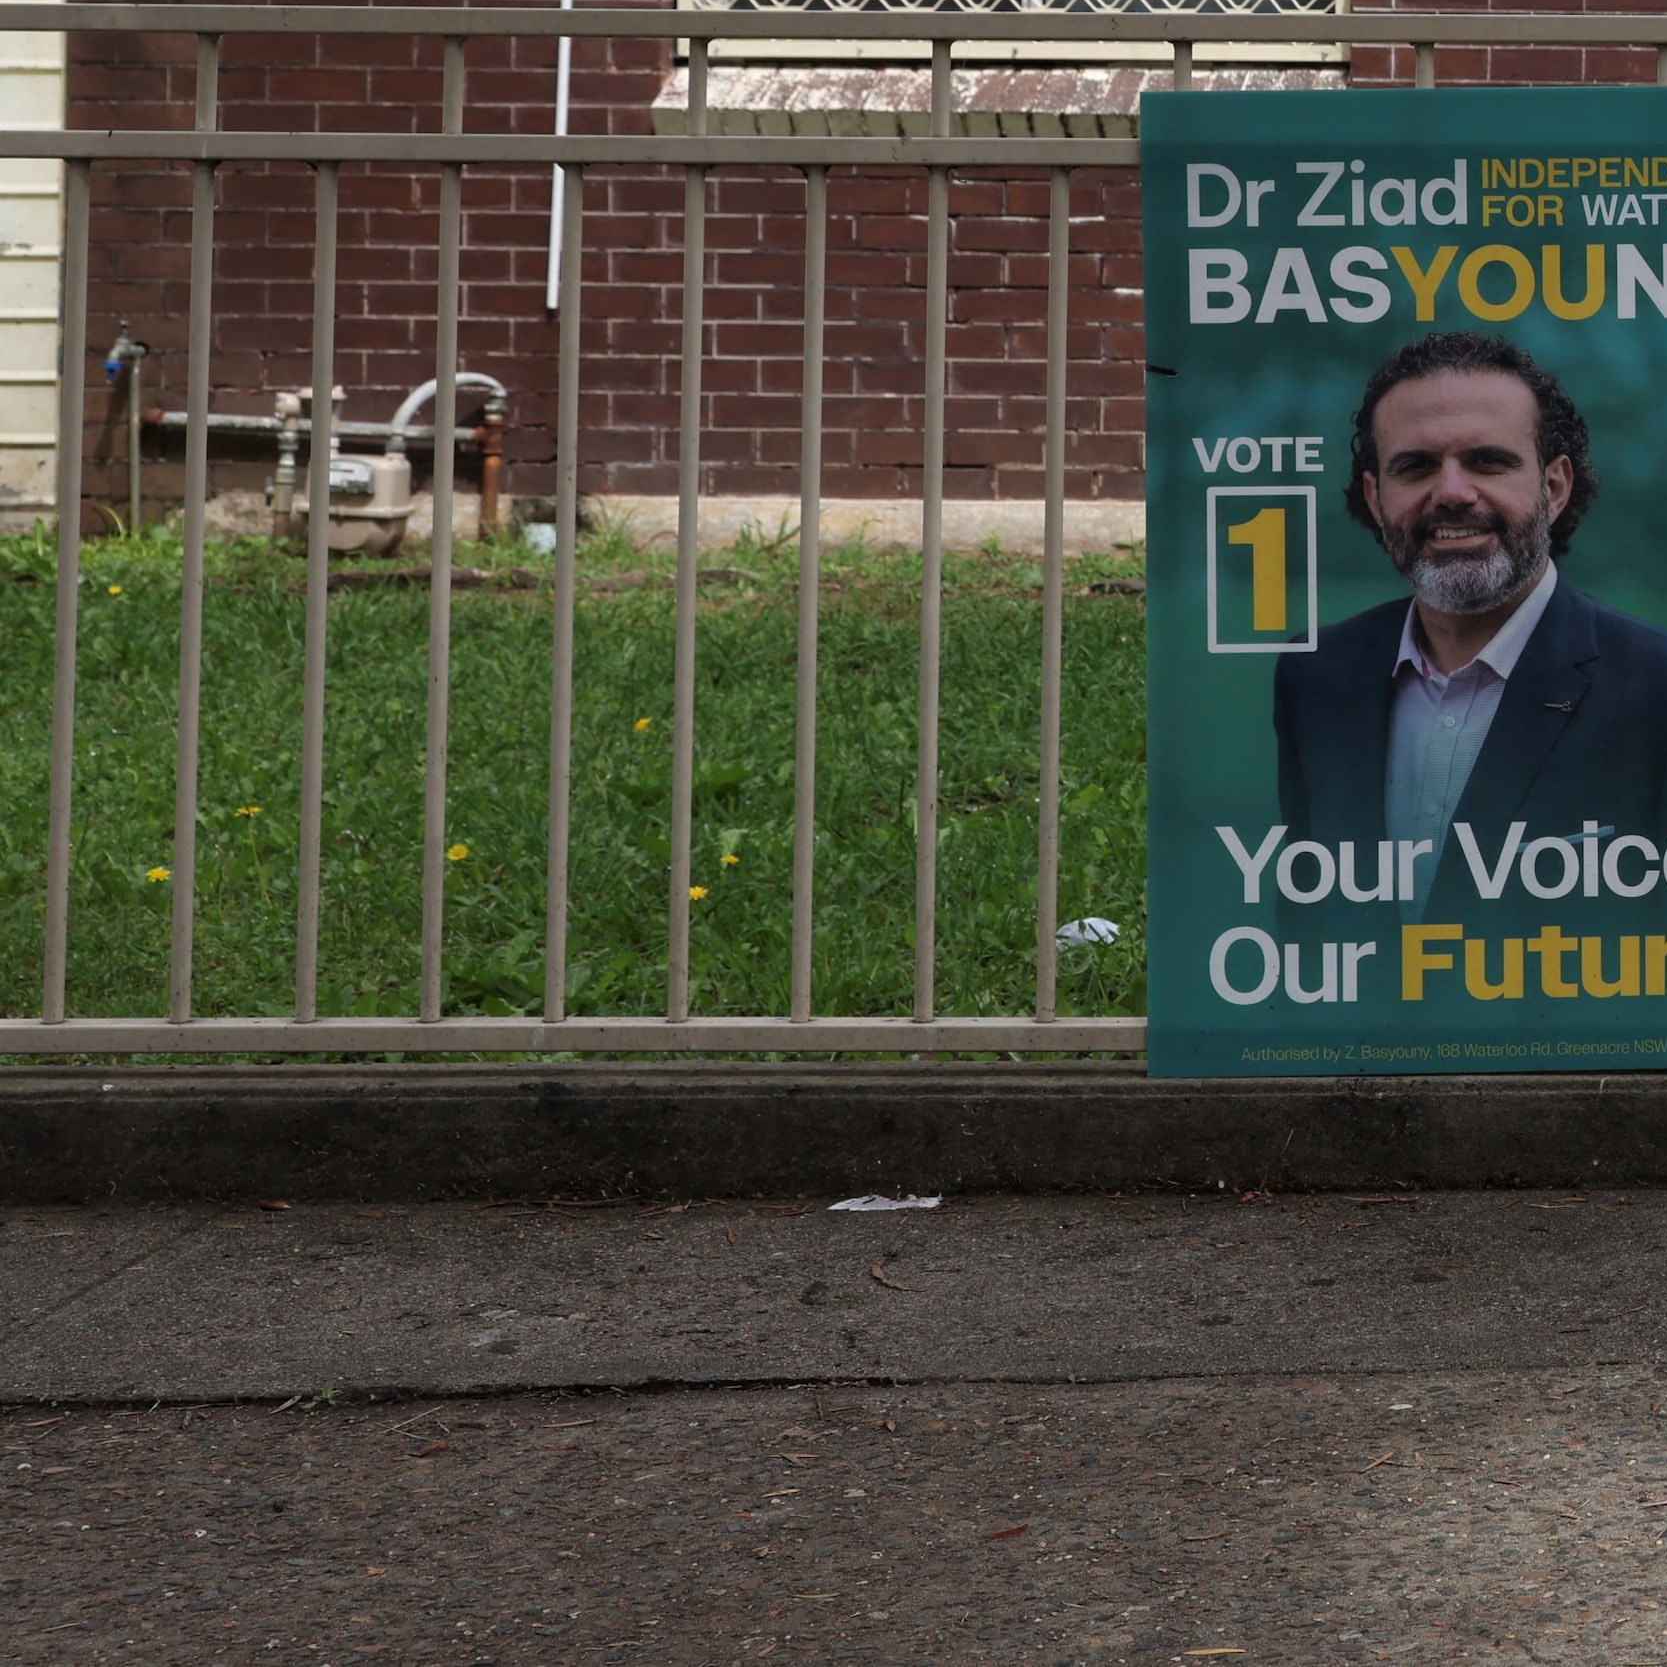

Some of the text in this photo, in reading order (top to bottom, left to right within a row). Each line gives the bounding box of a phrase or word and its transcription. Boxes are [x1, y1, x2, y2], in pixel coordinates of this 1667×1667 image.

[1187, 159, 1468, 228] Dr Ziad
[1481, 194, 1564, 227] FOR
[1192, 436, 1325, 473] VOTE
[1228, 507, 1287, 631] 1
[1215, 825, 1433, 904] Your
[1209, 926, 1377, 1005] Our
[1240, 1047, 1320, 1061] Authorised
[1322, 1046, 1342, 1063] by
[1437, 1043, 1460, 1058] 168
[1463, 1042, 1527, 1058] Waterloo
[1556, 1041, 1630, 1056] Greenacre
